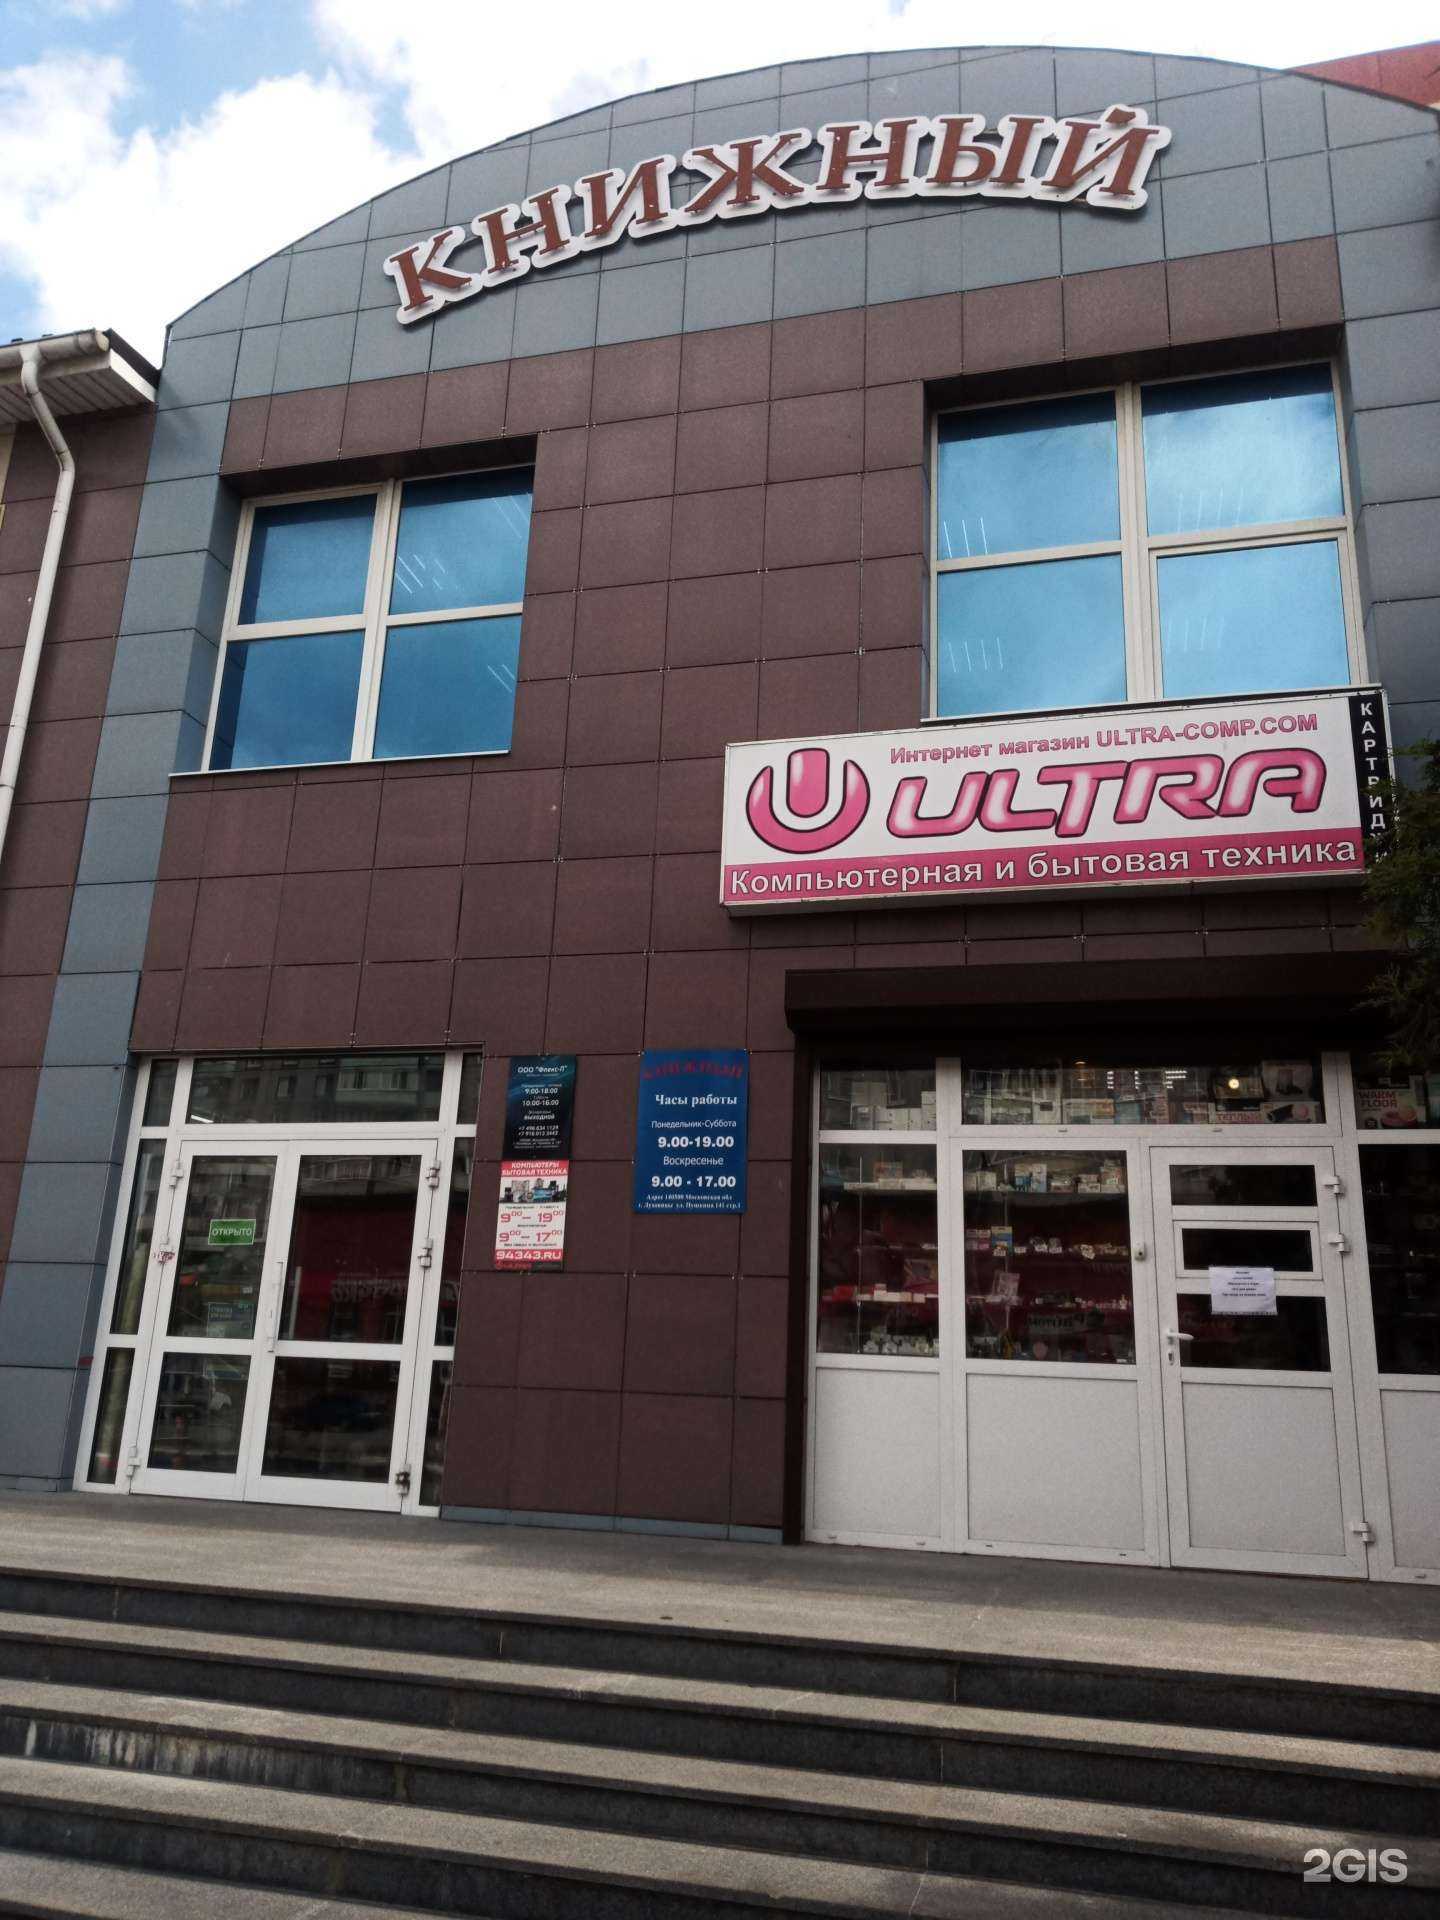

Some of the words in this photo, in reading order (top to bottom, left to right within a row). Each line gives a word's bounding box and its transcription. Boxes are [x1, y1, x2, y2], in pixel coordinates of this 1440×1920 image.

[384, 105, 1171, 325] КНИЖНЫЙ
[890, 743, 993, 765] Интернет
[998, 735, 1090, 757] магазин
[1096, 713, 1318, 748] ULTRA-COMP.COM
[1360, 702, 1387, 863] КАРТРИД
[886, 747, 1327, 838] ULTRA
[731, 860, 983, 896] Компьютерная
[995, 860, 1015, 880] и
[1027, 851, 1190, 878] бытовая
[1202, 841, 1357, 869] техника
[655, 1094, 688, 1105] Часы
[692, 1093, 737, 1108] работы
[651, 1119, 737, 1128] Понедельник-Суббота
[658, 1136, 734, 1148] 9.00-19.00
[663, 1155, 724, 1167] Воскресенье
[651, 1176, 683, 1188] 9.00
[696, 1175, 737, 1188] 17.00
[212, 1228, 252, 1236] ОТКРЫТО
[496, 1250, 562, 1260] 94343.RU
